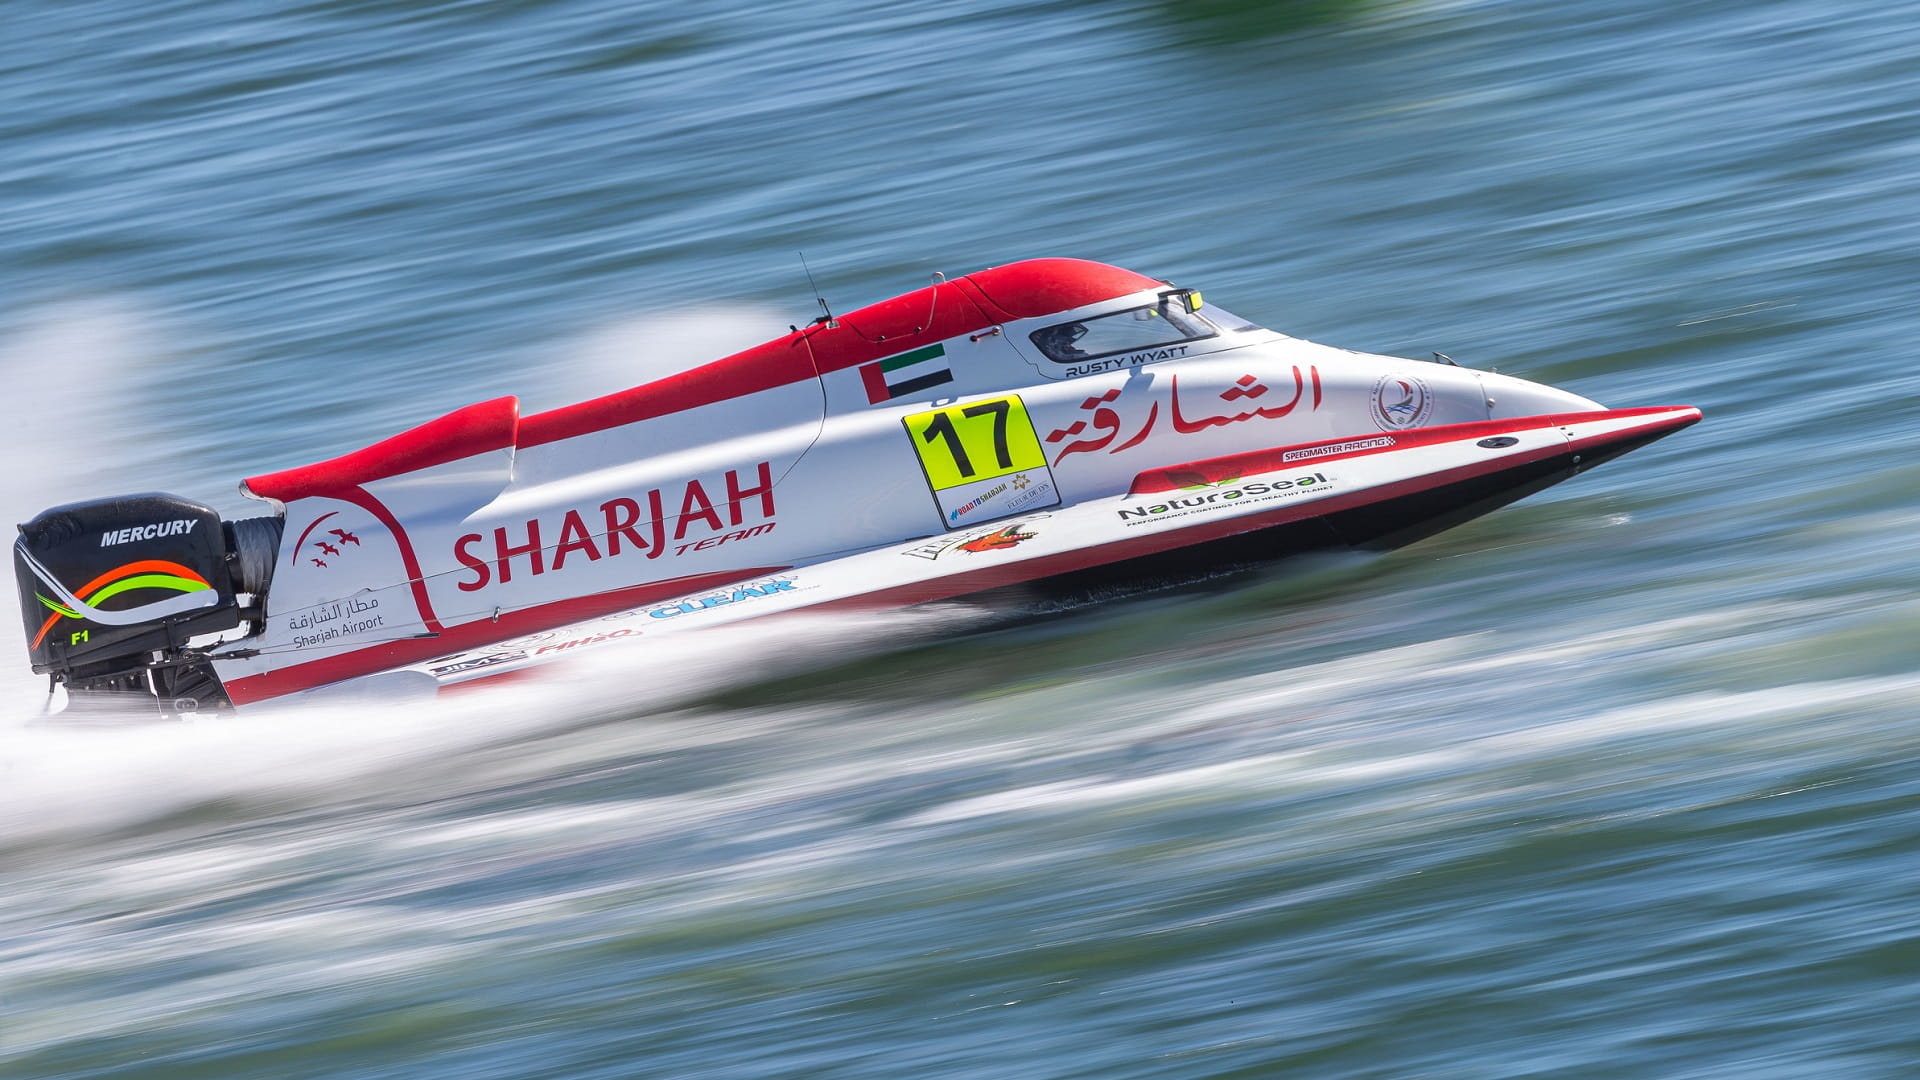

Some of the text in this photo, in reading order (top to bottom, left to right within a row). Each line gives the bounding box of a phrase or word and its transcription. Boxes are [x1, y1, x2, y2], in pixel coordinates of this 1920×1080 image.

[1066, 346, 1188, 377] RUSTY WYATT
[1045, 365, 1322, 469] الشارقة
[922, 400, 1014, 478] 17
[1285, 438, 1385, 460] SPEEDMASTER RACING
[1117, 473, 1327, 520] NaturaSeal
[1126, 510, 1189, 527] PERFORMANCE
[1190, 502, 1233, 515] COATINGS
[1234, 499, 1252, 507] FOR
[1261, 491, 1299, 502] HEALTHY
[1301, 485, 1334, 494] PLANET
[101, 518, 199, 548] MERCURY
[454, 461, 776, 592] SHARJAH
[673, 522, 777, 557] TEAM
[289, 598, 379, 630] مطار الشارقة
[649, 580, 797, 619] CLEAR
[71, 629, 90, 646] F1
[293, 614, 384, 649] Sharjah Airport
